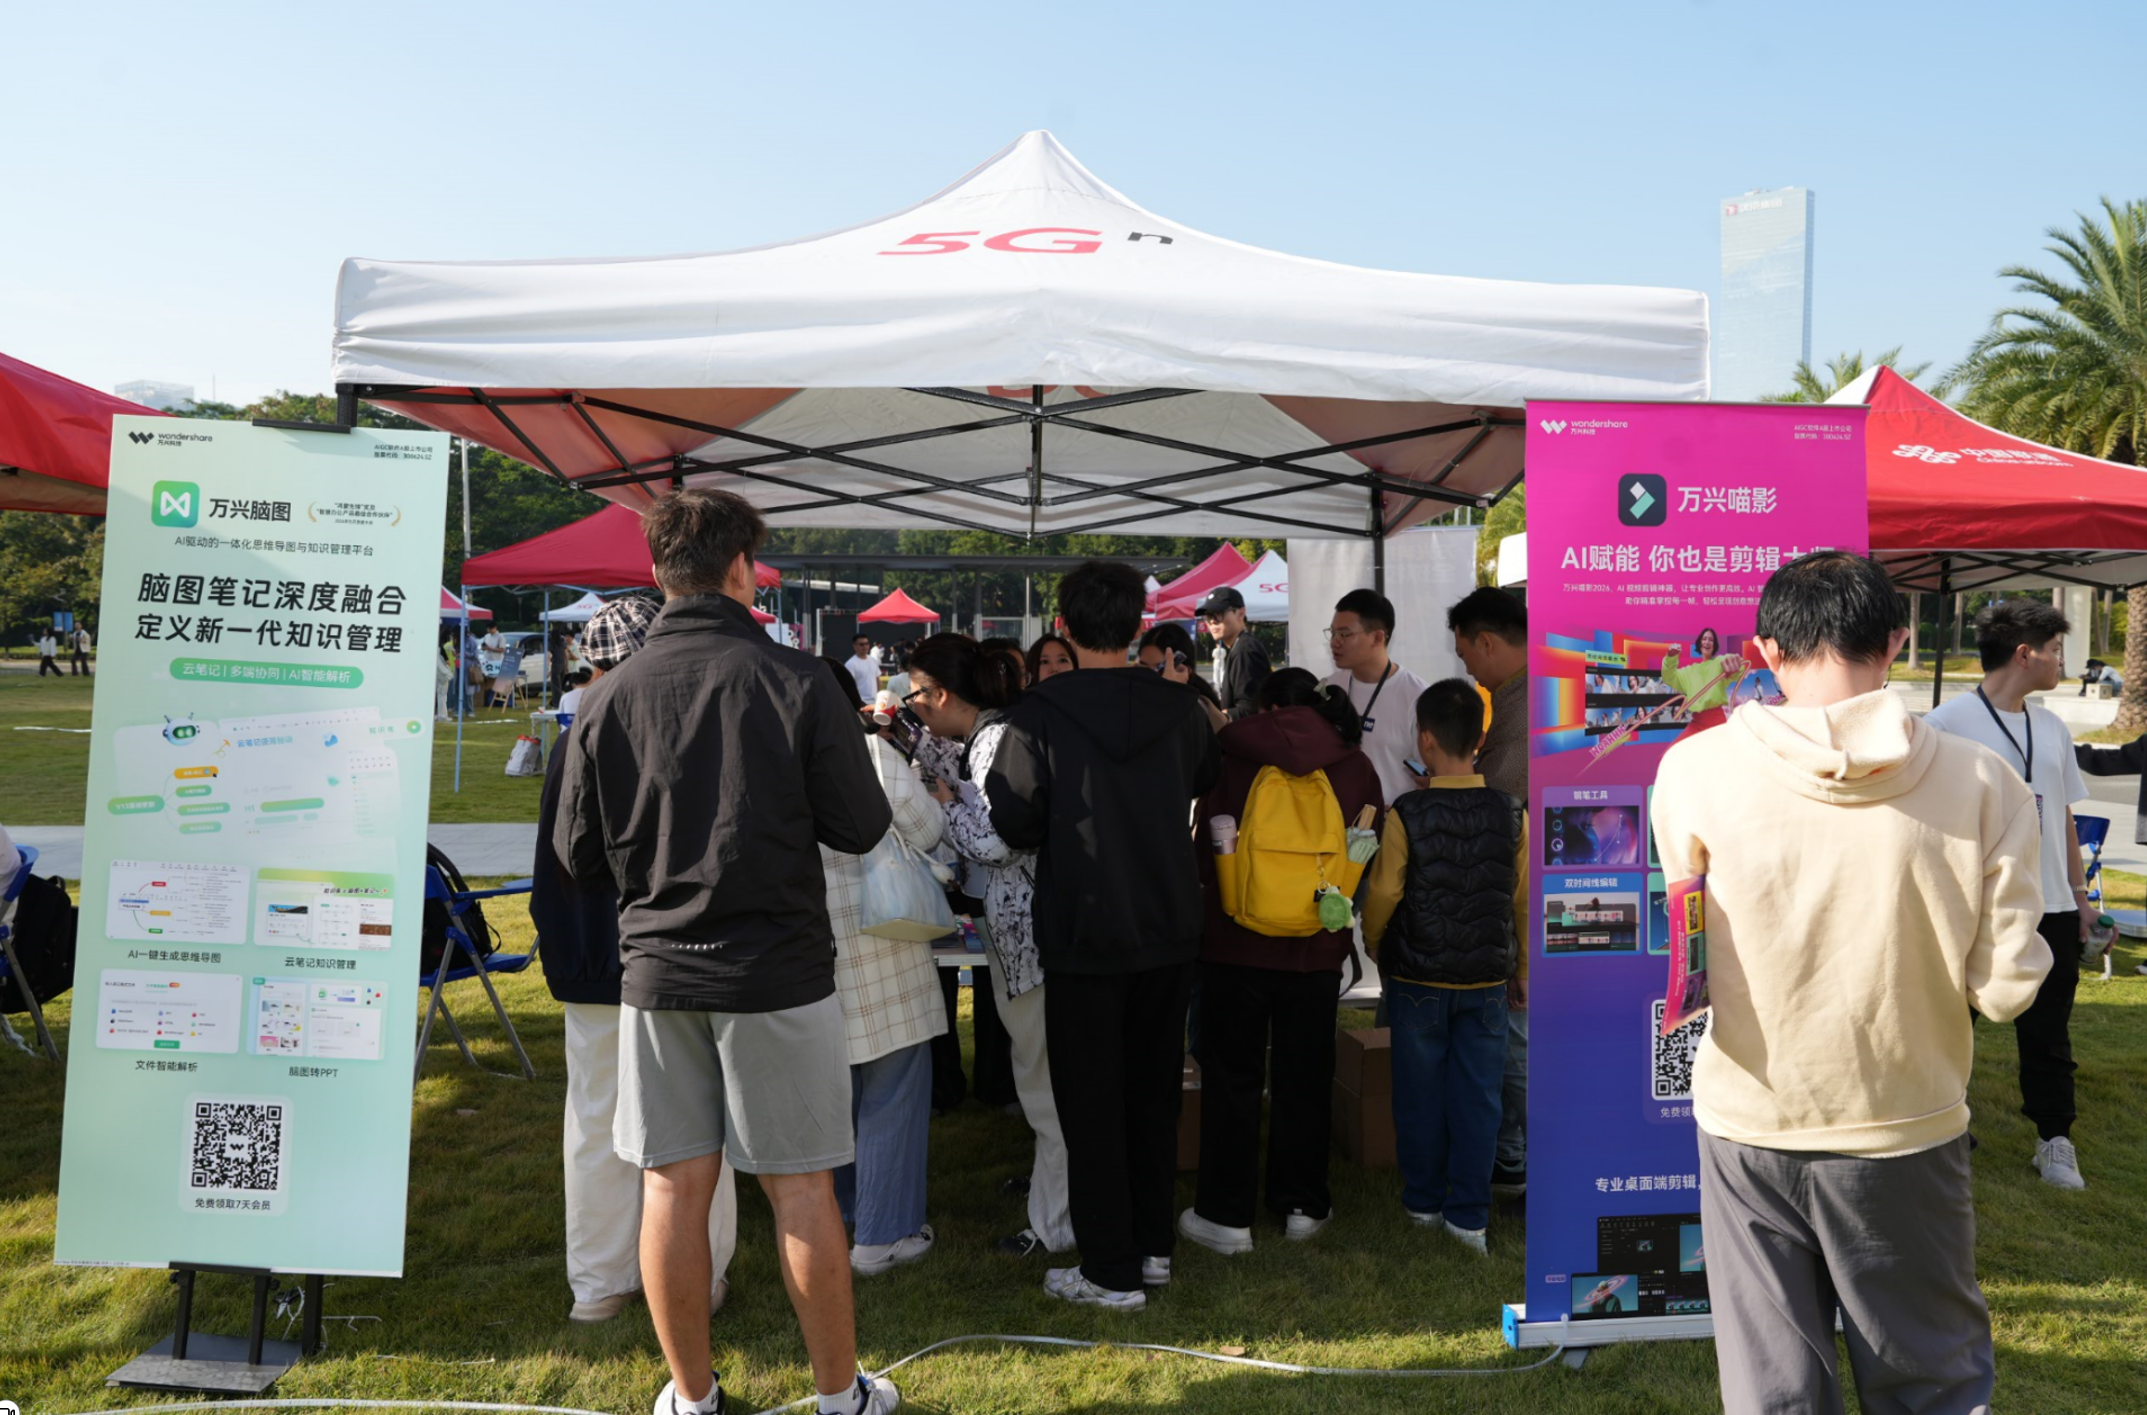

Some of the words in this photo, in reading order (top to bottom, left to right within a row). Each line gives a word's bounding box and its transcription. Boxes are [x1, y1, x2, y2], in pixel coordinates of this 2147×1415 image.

[876, 227, 1103, 255] 5G
[1571, 419, 1628, 428] wondershare
[158, 432, 213, 442] wondershare
[1677, 486, 1777, 514] 万兴喵影
[208, 498, 292, 522] 万兴脑图
[1561, 545, 1640, 573] AI赋能
[1648, 545, 1835, 573] 你也是剪辑
[137, 572, 407, 615] 脑图笔记深度融合
[134, 613, 403, 653] 定义新一代知识管理
[182, 662, 221, 677] 云笔记
[230, 665, 280, 680] 多端协同
[289, 669, 351, 684] AI智能解析
[1564, 877, 1618, 888] 双时间线编辑
[128, 950, 222, 964] AI一键生成思维导图
[285, 956, 357, 971] 云笔记知识管理
[135, 1059, 198, 1073] 文件智能解析
[289, 1065, 339, 1079] 脑图转PPT
[1660, 1107, 1694, 1118] 免费领
[195, 1198, 272, 1211] 免费领取7天会员
